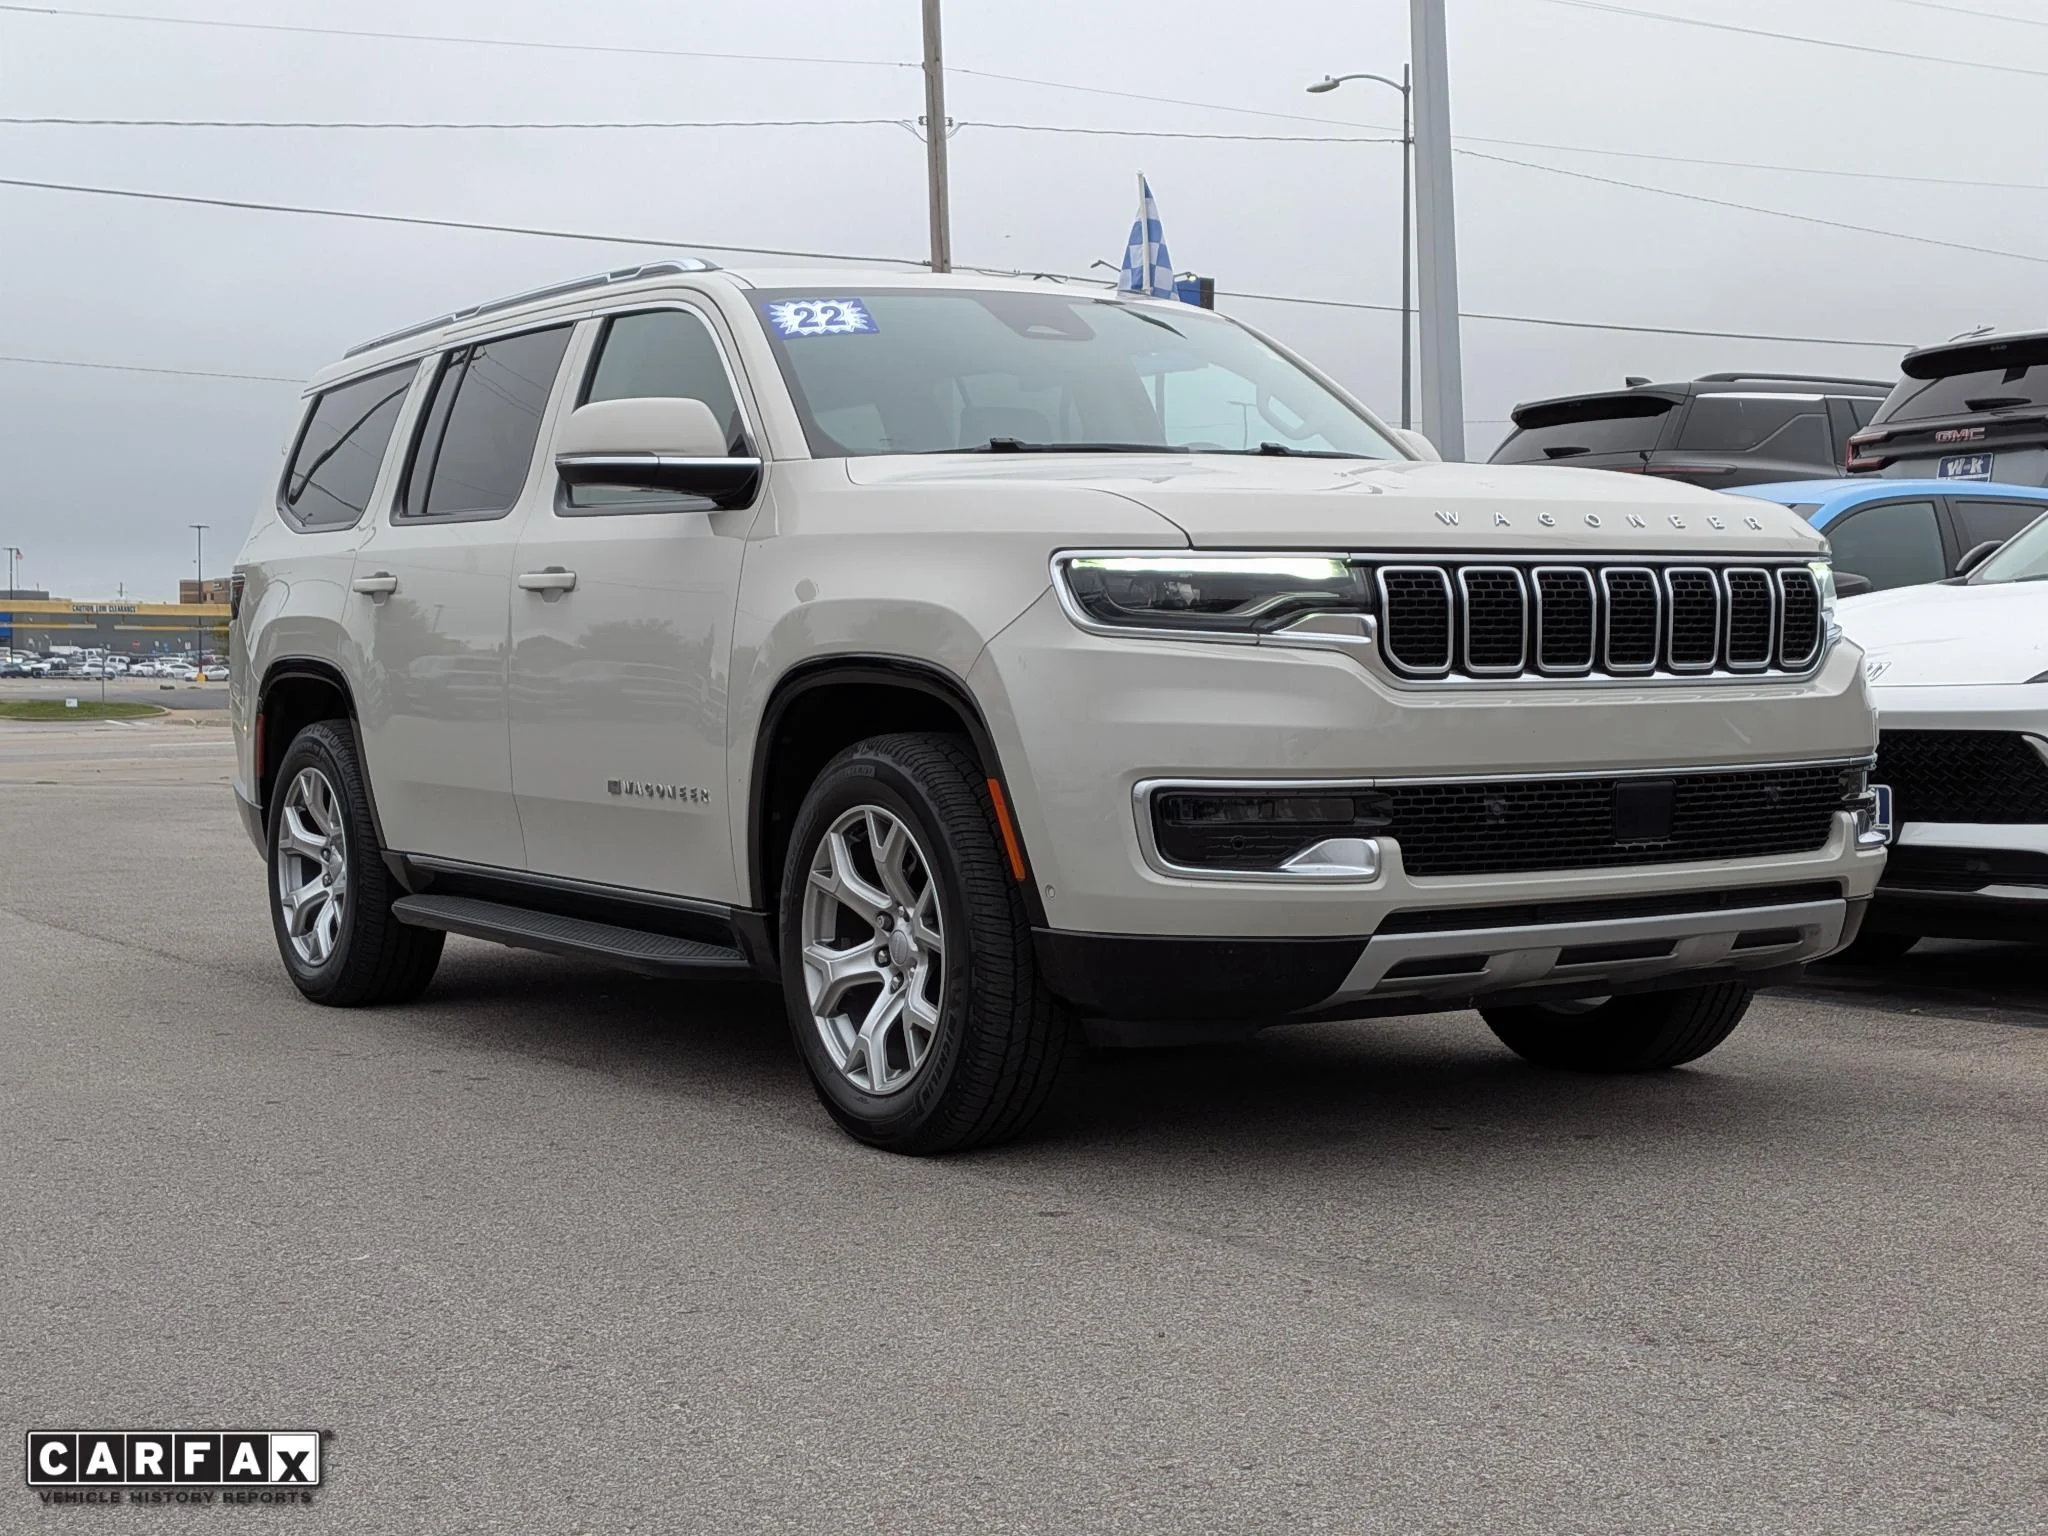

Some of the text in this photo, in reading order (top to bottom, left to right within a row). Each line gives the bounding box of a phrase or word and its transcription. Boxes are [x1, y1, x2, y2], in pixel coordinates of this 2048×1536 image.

[793, 305, 848, 328] 22
[1935, 427, 1985, 442] GMC
[1435, 510, 1763, 531] WAGONEER
[622, 780, 710, 802] WAGONEER
